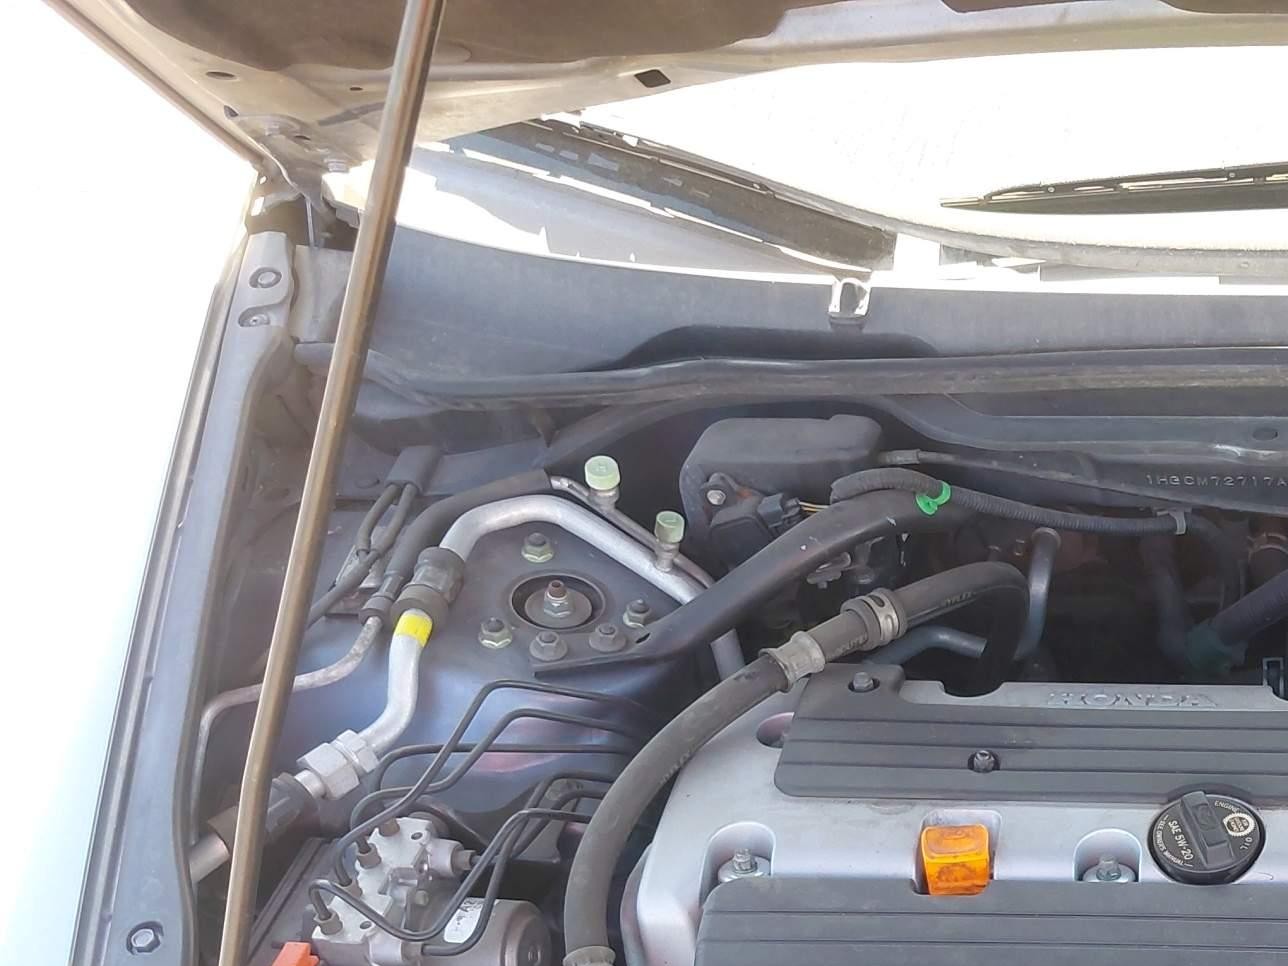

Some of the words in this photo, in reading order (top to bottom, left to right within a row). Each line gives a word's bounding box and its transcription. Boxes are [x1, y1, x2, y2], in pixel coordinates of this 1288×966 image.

[1049, 691, 1218, 708] HONDA
[1214, 800, 1240, 813] ENGINE
[1168, 820, 1181, 835] SAE
[1174, 834, 1194, 860] 5W-20
